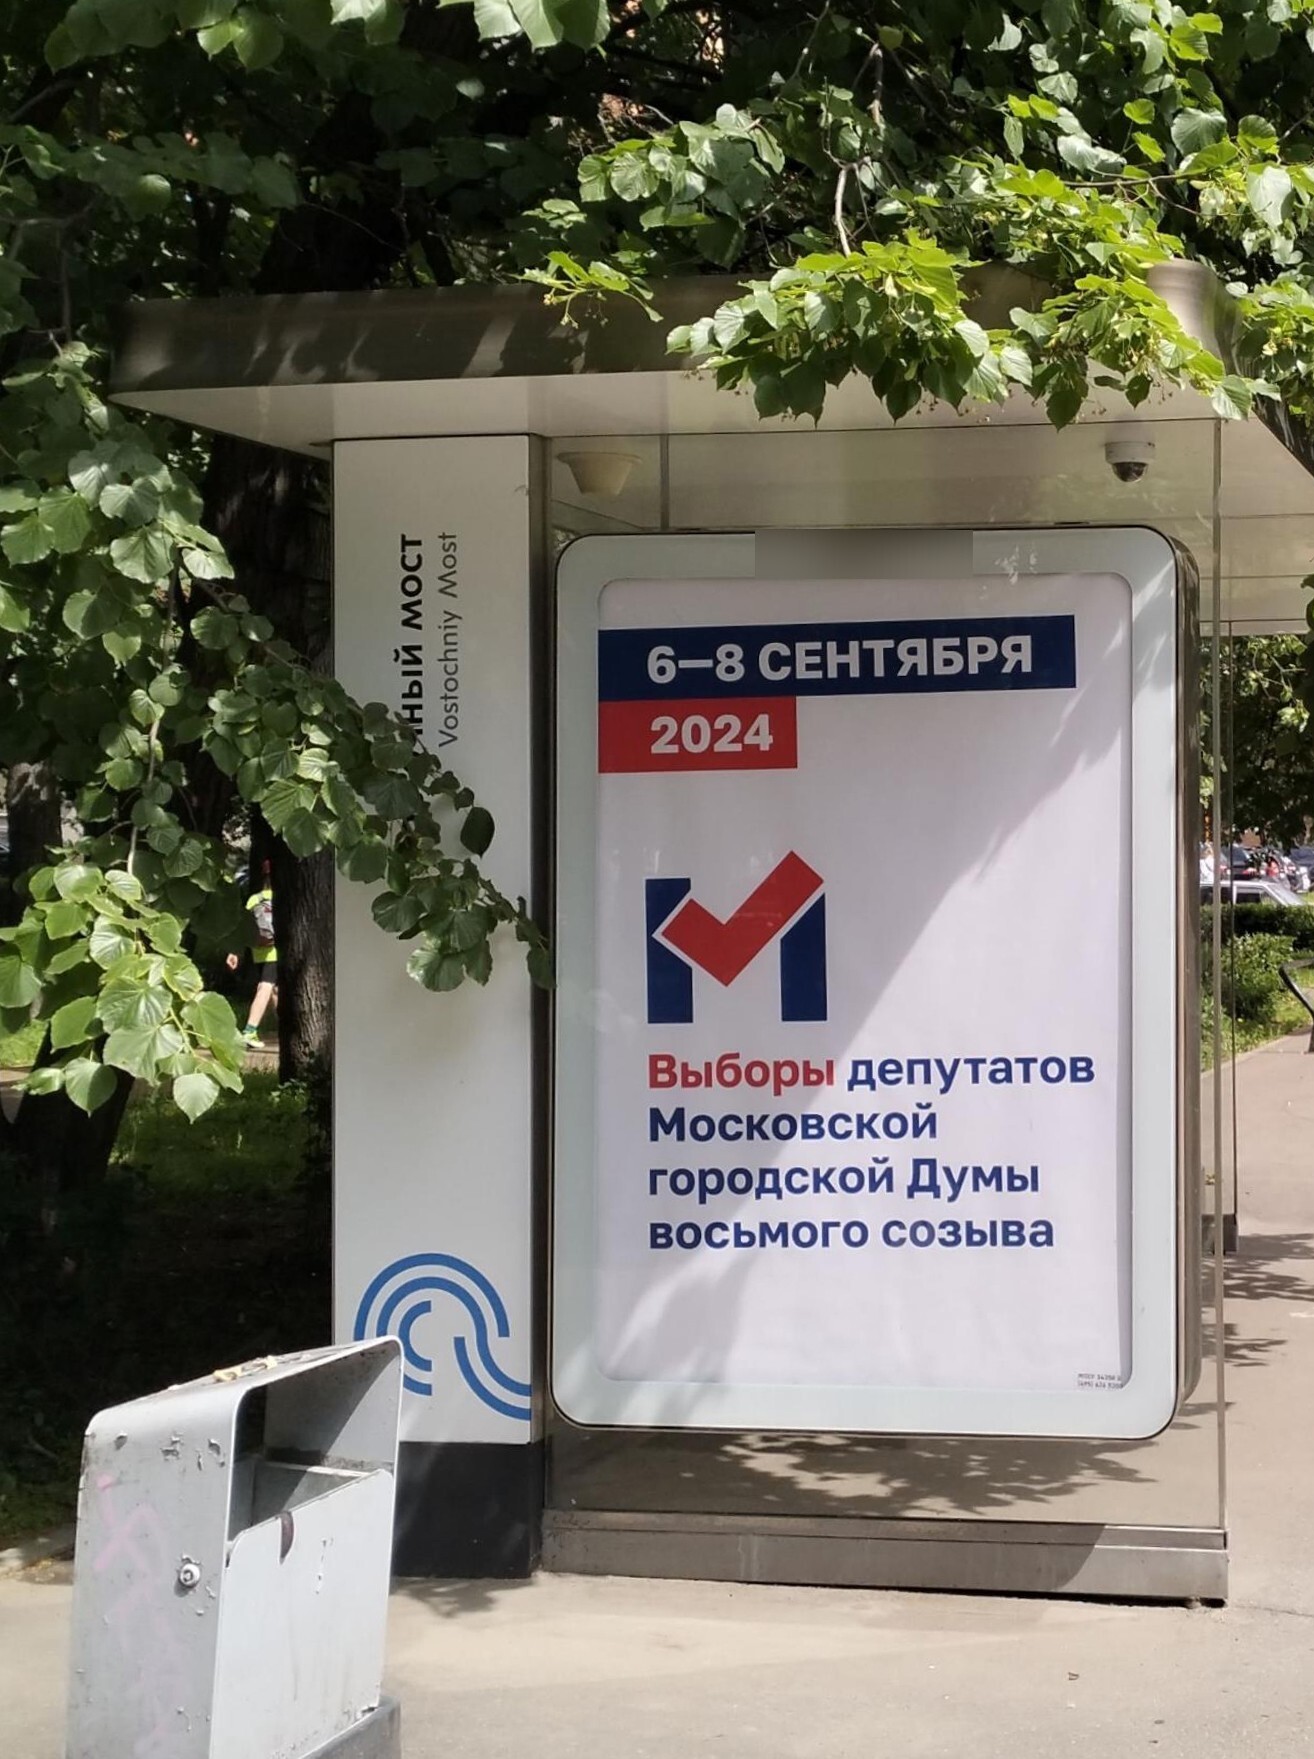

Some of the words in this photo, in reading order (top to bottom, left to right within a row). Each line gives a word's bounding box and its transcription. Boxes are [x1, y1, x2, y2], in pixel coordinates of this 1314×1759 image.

[437, 532, 458, 598] Most
[437, 610, 463, 748] Vostochniy
[757, 635, 1034, 681] СЕНТЯБРЯ
[649, 713, 774, 755] 2024
[647, 1052, 835, 1096] Выборы
[847, 1056, 1095, 1093] депутатов
[648, 1102, 938, 1142] Московской
[648, 1157, 895, 1205] городской
[906, 1158, 1040, 1202] Думы
[649, 1219, 869, 1250] восьмого
[881, 1218, 1055, 1248] созыва
